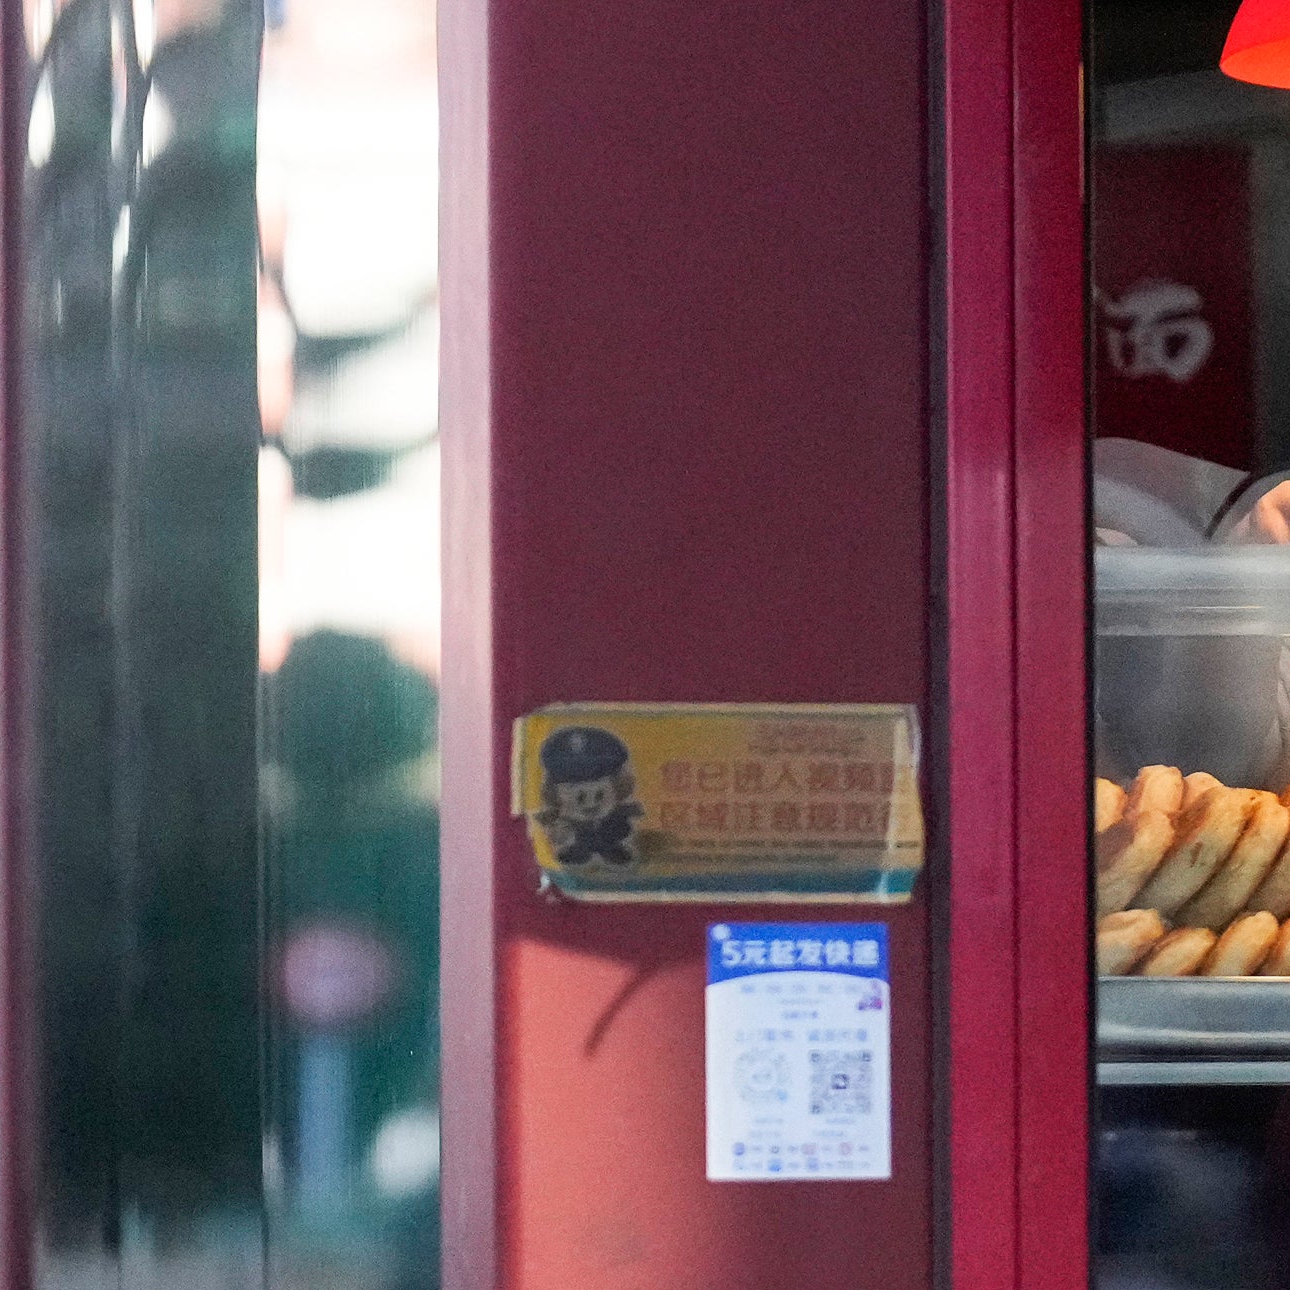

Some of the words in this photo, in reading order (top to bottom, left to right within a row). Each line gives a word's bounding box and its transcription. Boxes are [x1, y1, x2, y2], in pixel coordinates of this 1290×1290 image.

[721, 939, 879, 967] 5元起发快递
